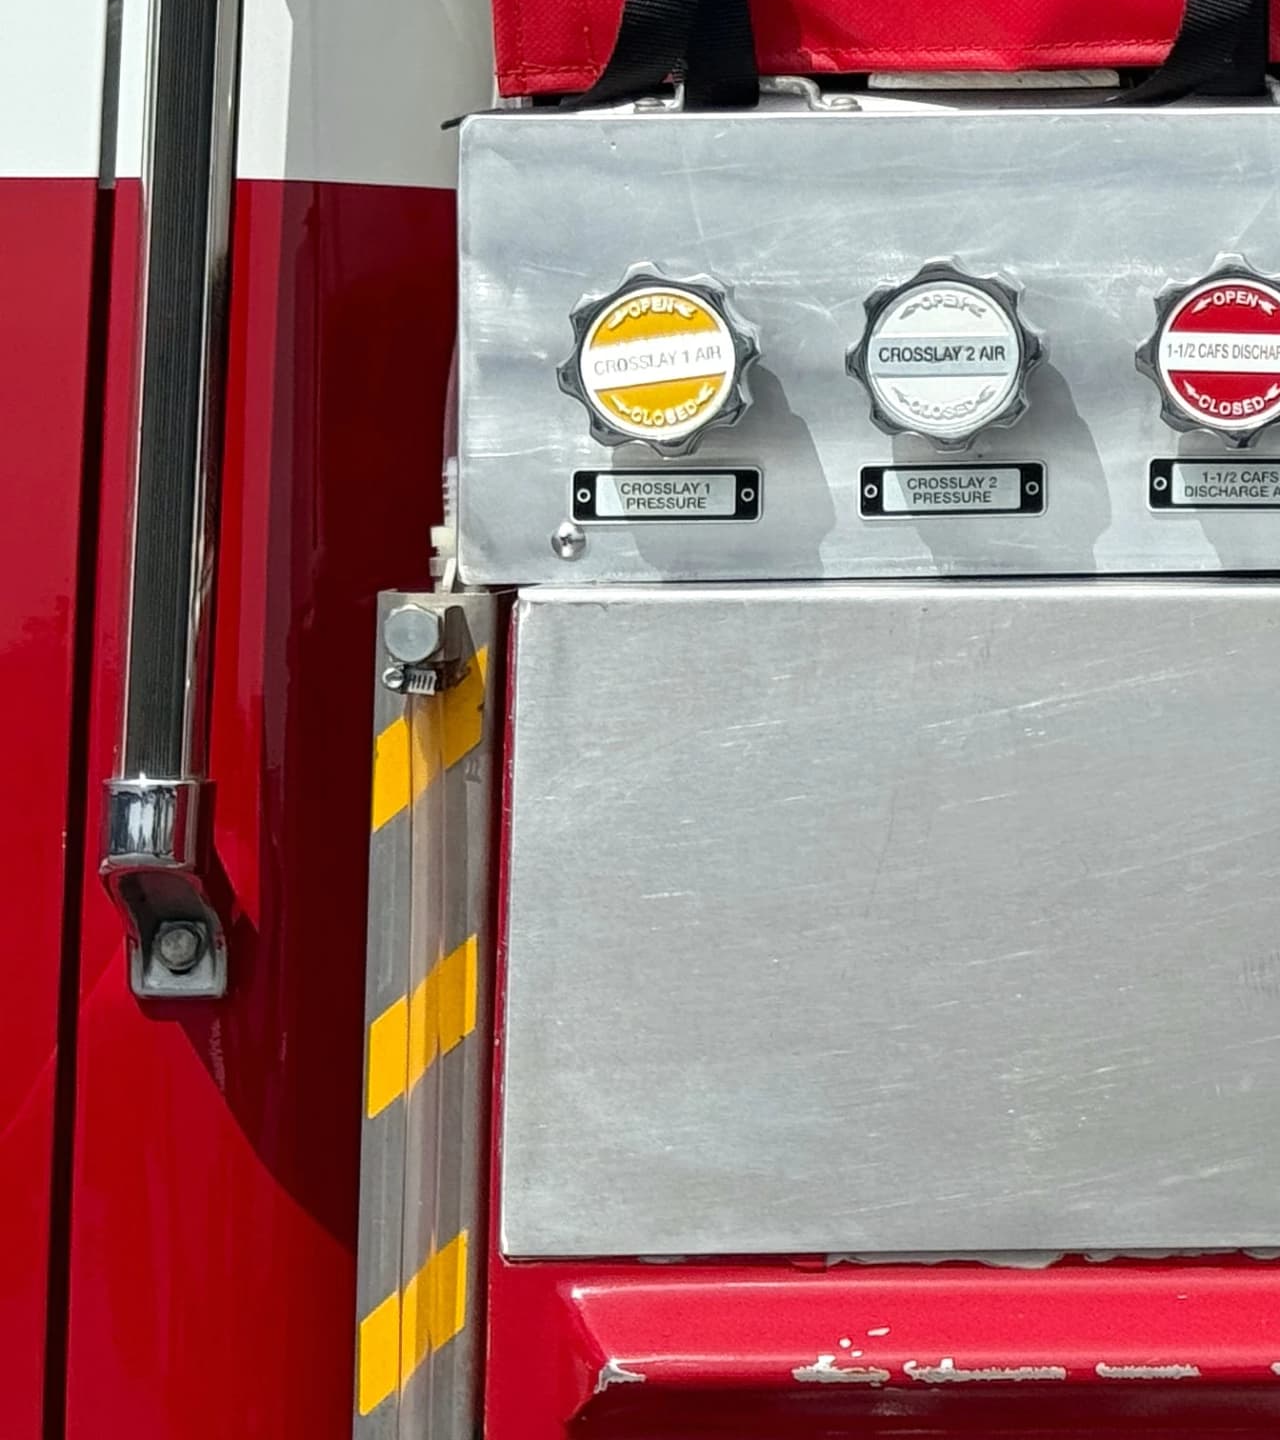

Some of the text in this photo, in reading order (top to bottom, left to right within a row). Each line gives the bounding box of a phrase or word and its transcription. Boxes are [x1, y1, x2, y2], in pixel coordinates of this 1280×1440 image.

[630, 296, 677, 317] OPEN
[1212, 290, 1259, 308] OPEN
[878, 345, 1006, 362] CROSSLAY 2 AIR
[1167, 343, 1195, 359] 1-1/2
[1198, 344, 1229, 360] CAFS
[593, 346, 722, 376] CROSSLAY 1 AIR
[630, 402, 698, 427] CLOSED
[1198, 396, 1265, 416] CLOSED
[907, 476, 998, 491] CROSSLAY 2
[1202, 471, 1279, 484] 1-1/2 CAFS
[620, 482, 710, 496] CROSSLAY 1
[913, 491, 992, 504] PRESSURE
[1185, 486, 1269, 498] DISCHARGE
[626, 497, 707, 510] PRESSURE
